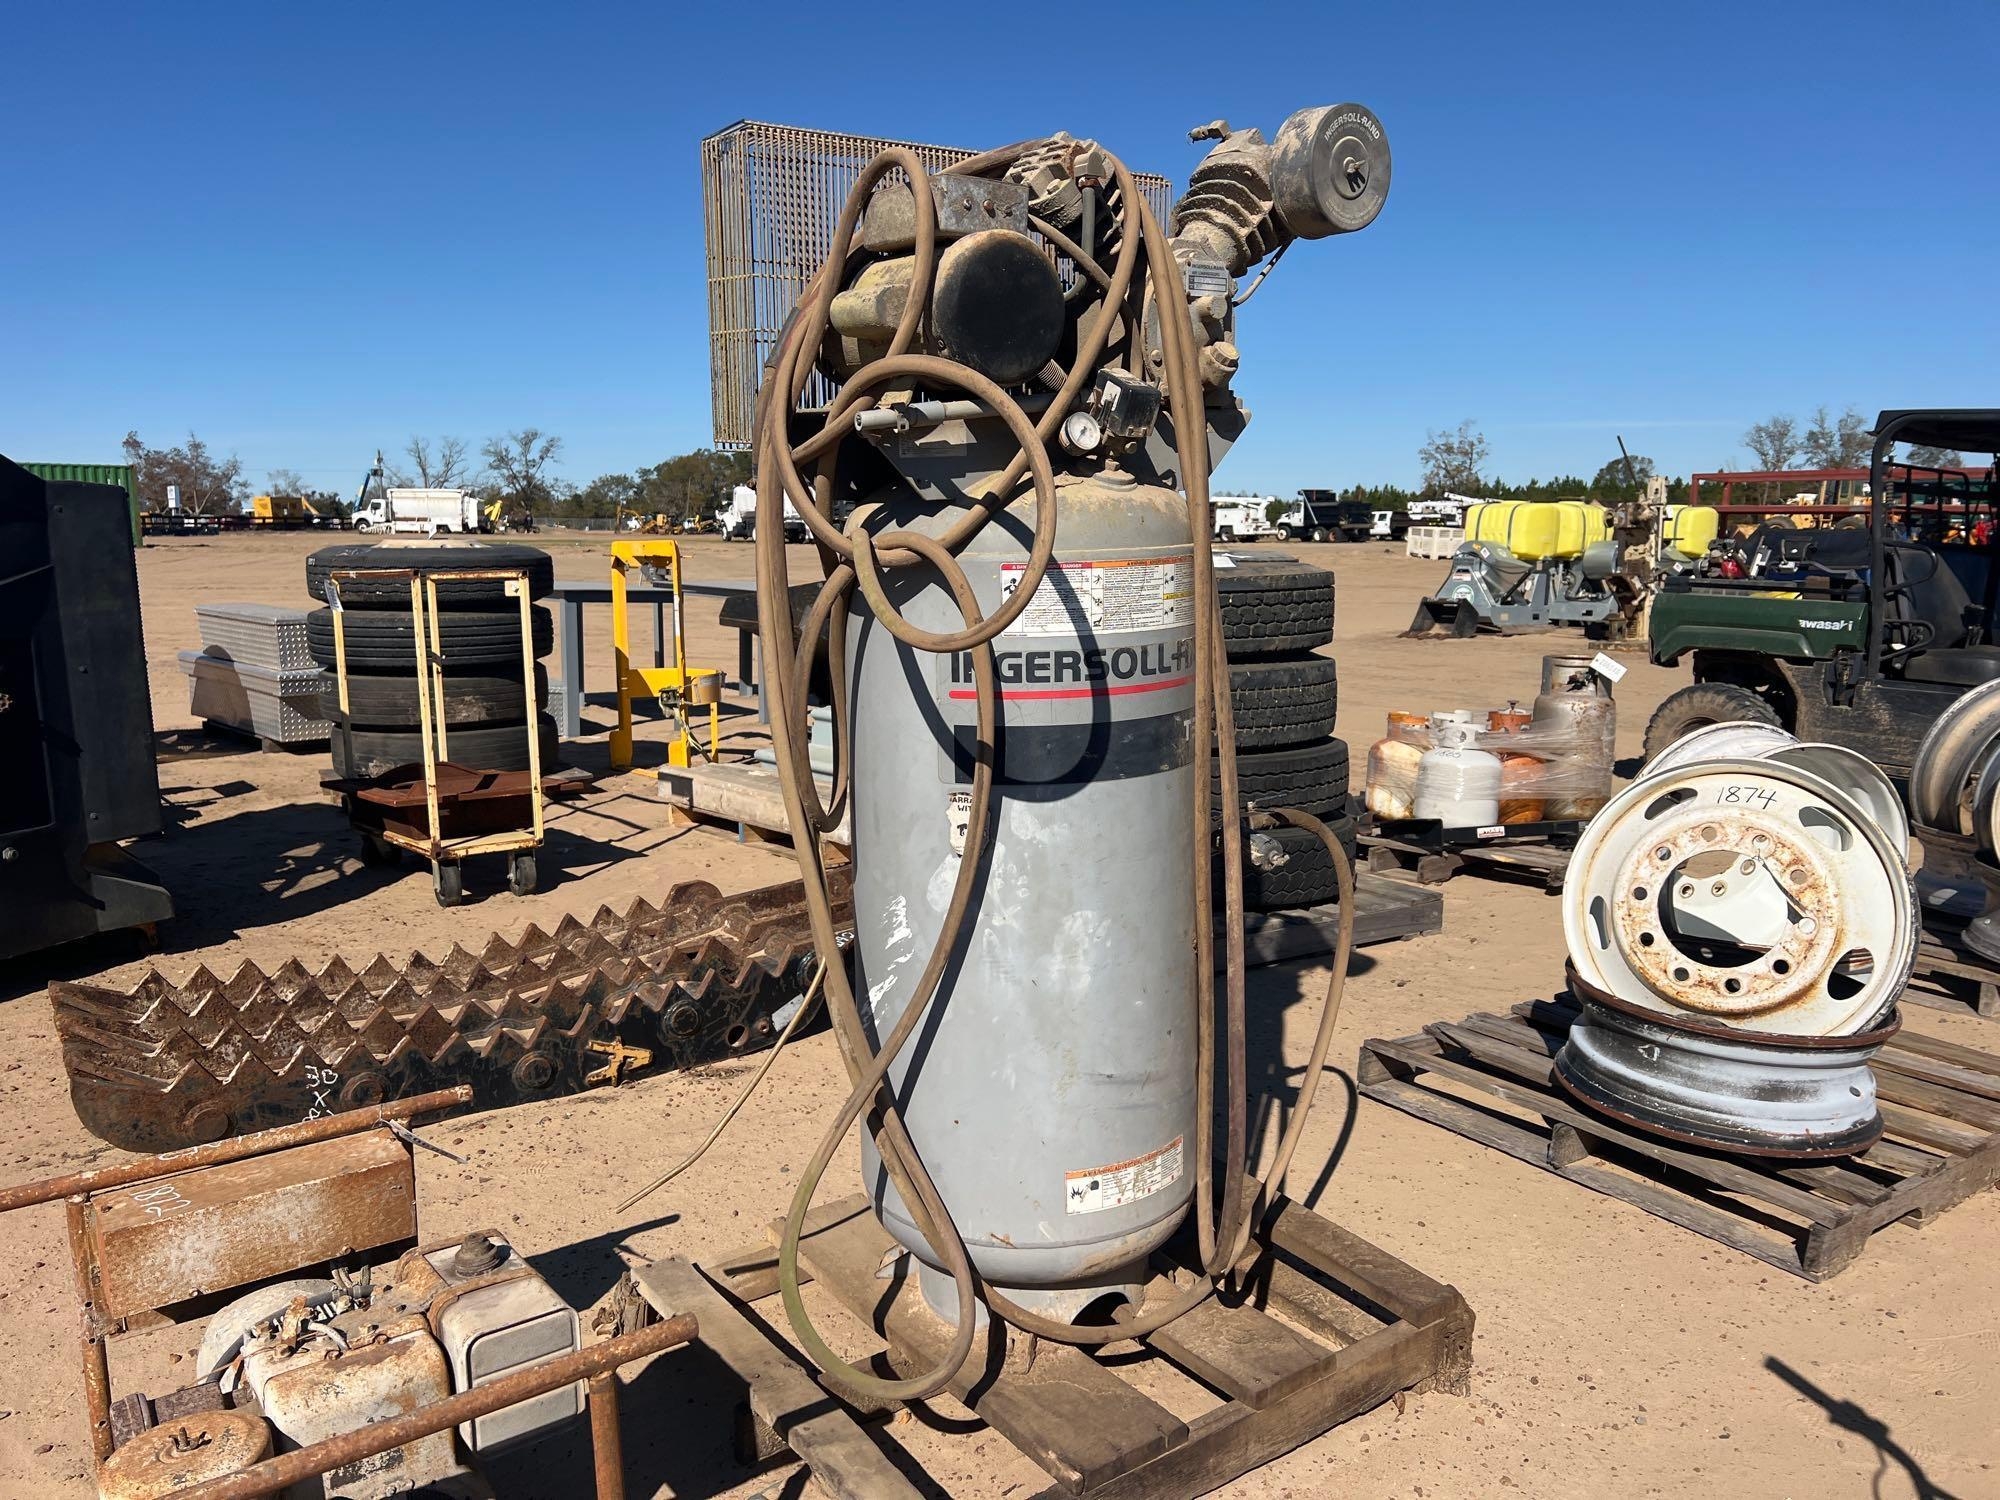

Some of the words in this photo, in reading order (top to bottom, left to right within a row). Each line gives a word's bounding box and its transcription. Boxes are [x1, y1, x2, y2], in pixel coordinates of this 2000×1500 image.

[1324, 112, 1380, 142] INGERSOLL-RAND
[1798, 619, 1853, 632] awasai
[1717, 786, 1777, 810] 1874
